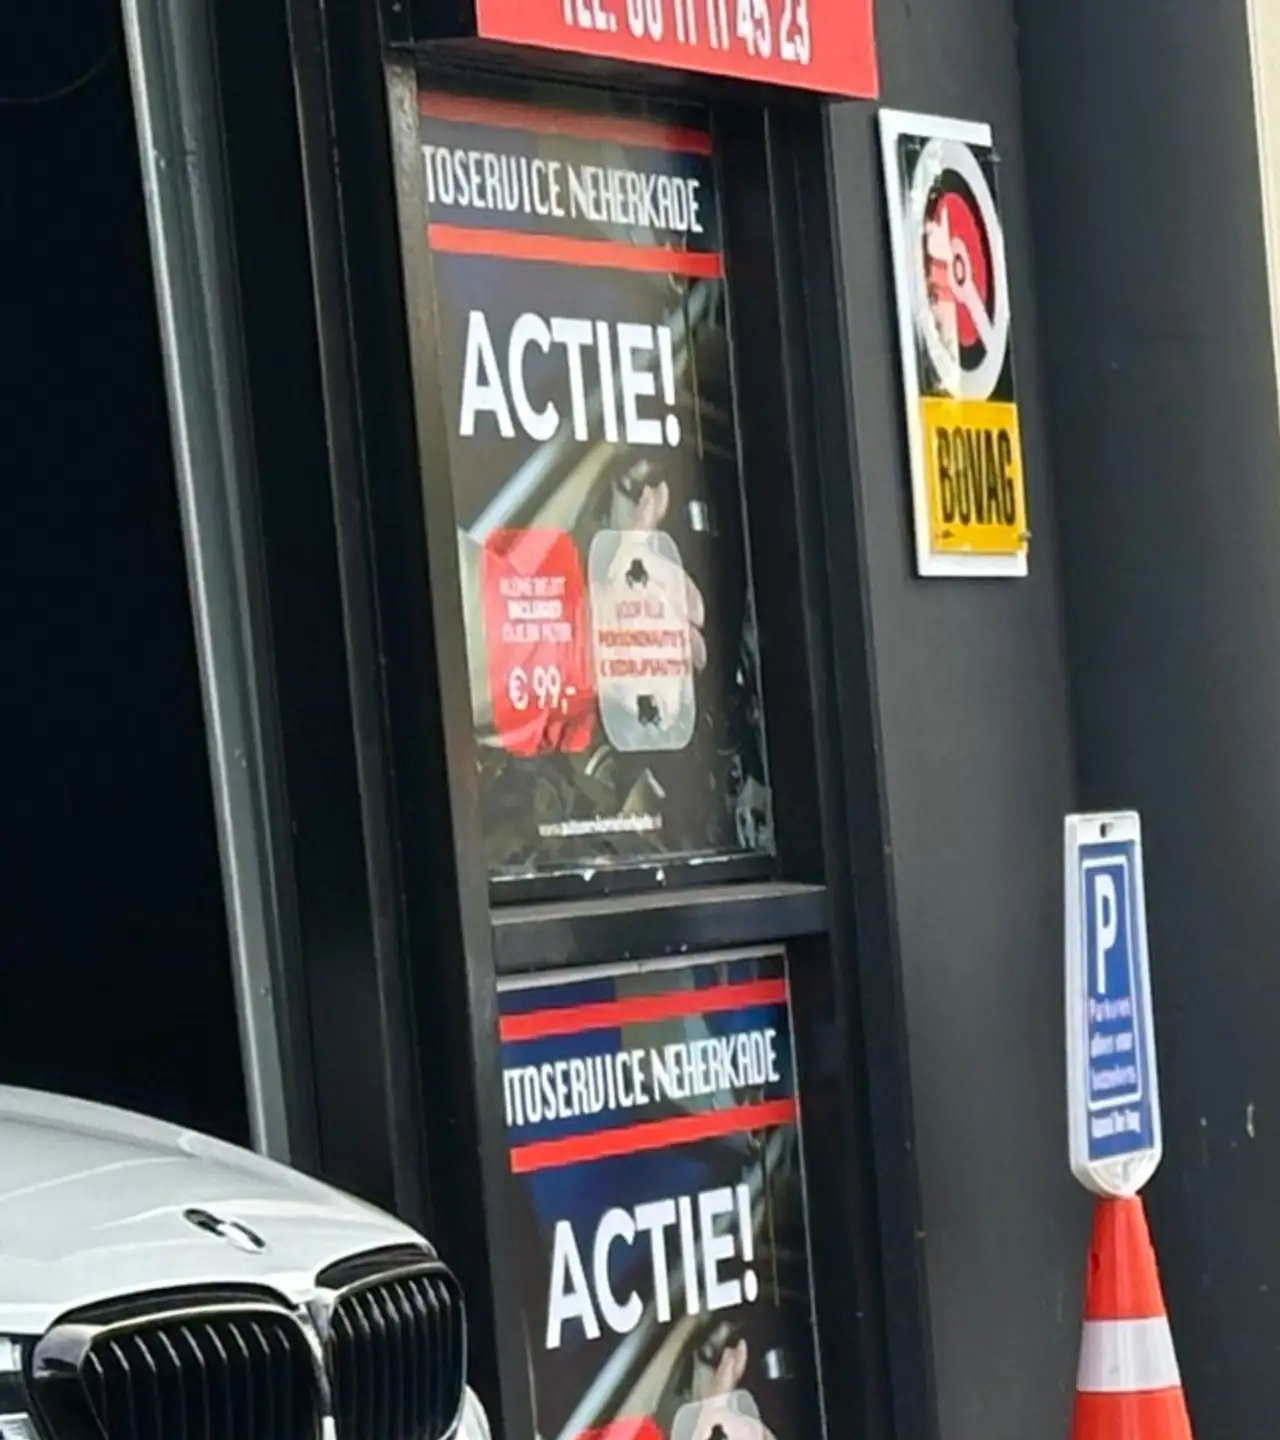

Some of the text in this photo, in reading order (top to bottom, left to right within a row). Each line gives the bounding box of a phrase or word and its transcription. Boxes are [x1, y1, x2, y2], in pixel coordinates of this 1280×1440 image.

[736, 0, 771, 59] 45
[779, 0, 810, 66] 23
[566, 161, 703, 232] NEHERKADE
[459, 310, 681, 448] ACTIE!
[936, 426, 1016, 527] BOVAG
[1094, 874, 1118, 994] P
[651, 1028, 781, 1102] NEHERKADE
[545, 1184, 758, 1350] ACTIE!
